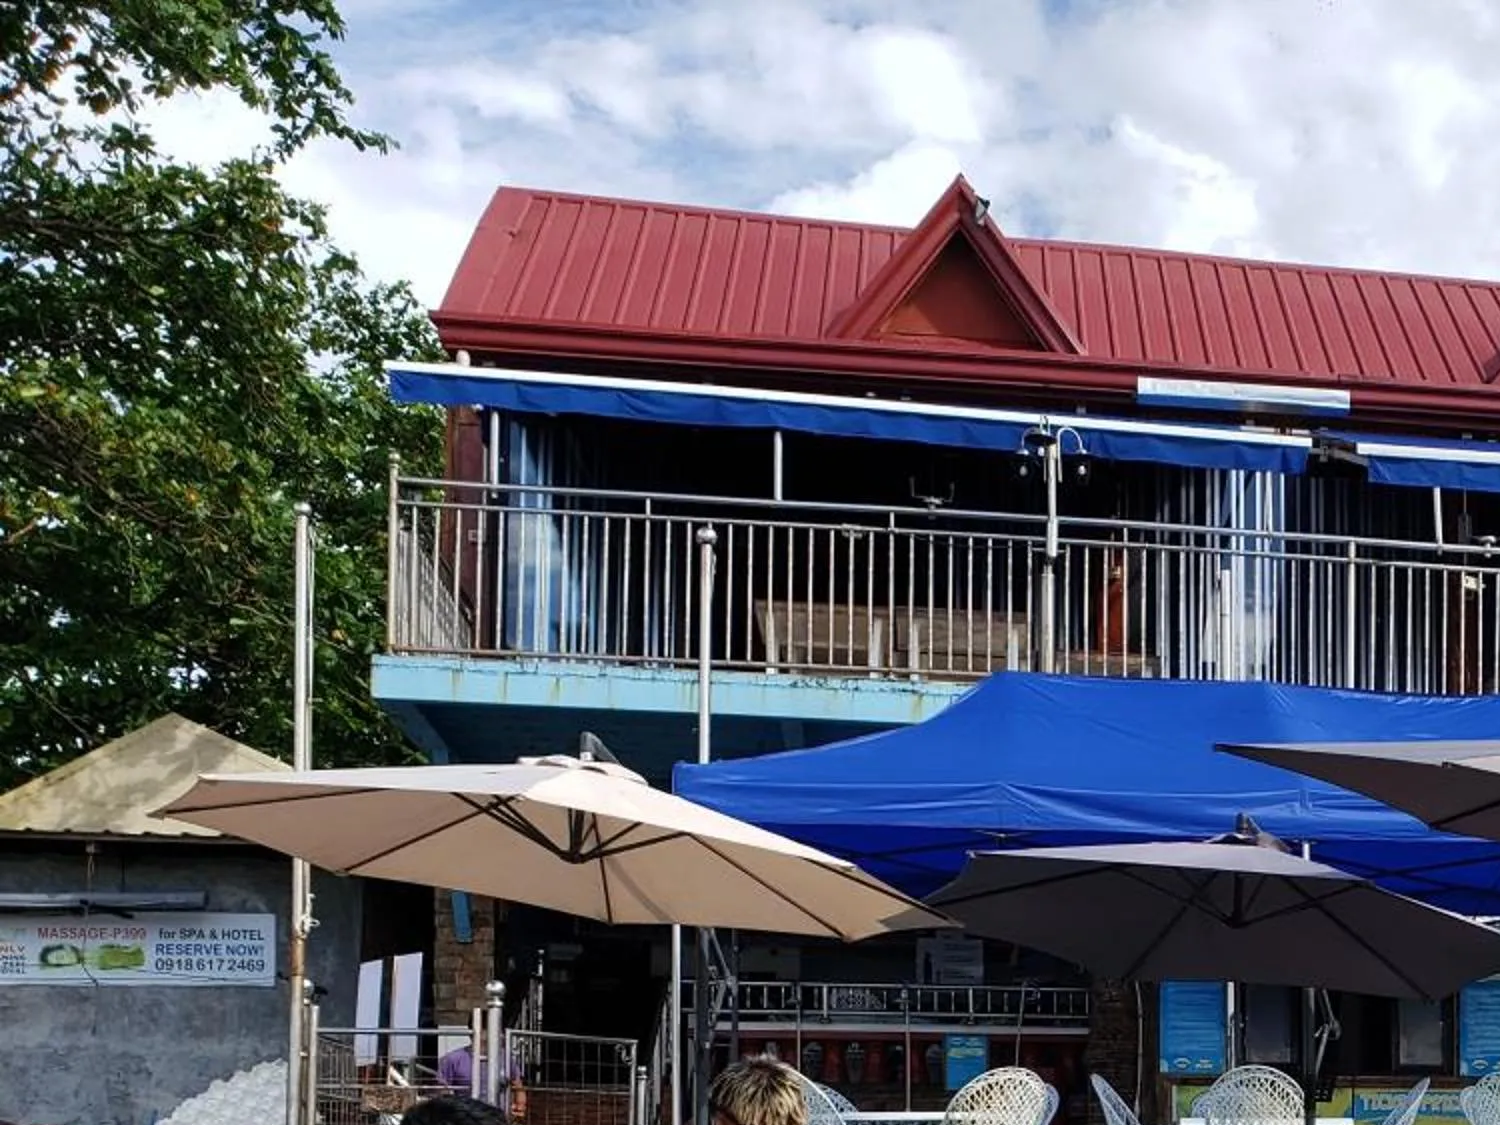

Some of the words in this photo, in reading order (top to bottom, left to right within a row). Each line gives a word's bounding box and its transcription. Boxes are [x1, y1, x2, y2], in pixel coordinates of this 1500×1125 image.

[159, 927, 176, 940] for
[179, 929, 205, 940] SPA
[209, 930, 218, 941] &
[222, 929, 265, 941] HOTEL
[155, 944, 224, 956] RESERVE
[155, 959, 196, 971] 0918
[197, 959, 223, 971] 617
[226, 959, 265, 972] 2469
